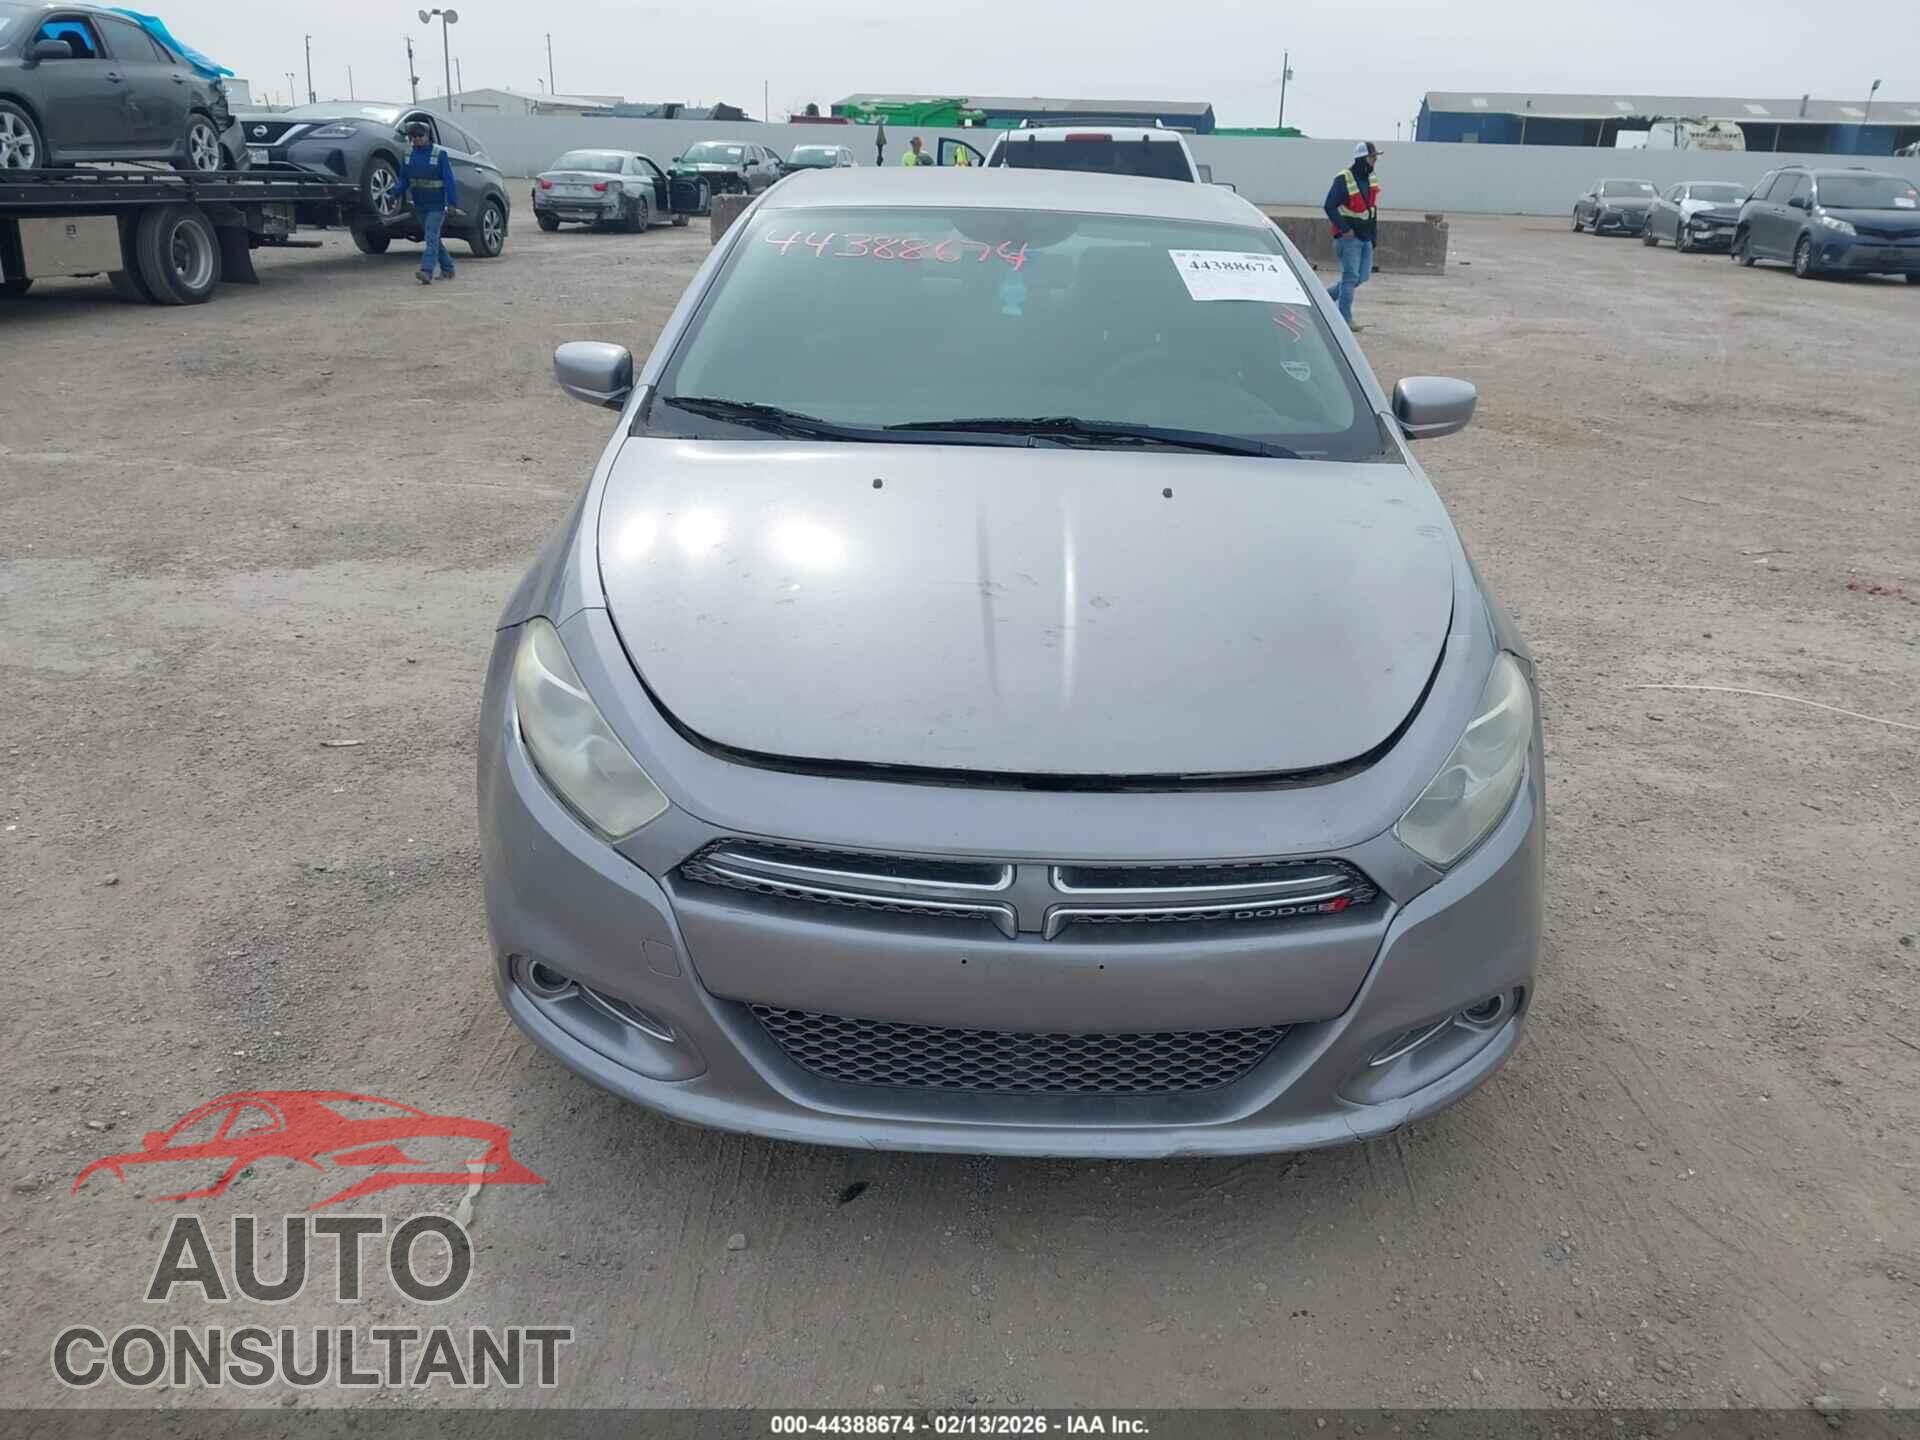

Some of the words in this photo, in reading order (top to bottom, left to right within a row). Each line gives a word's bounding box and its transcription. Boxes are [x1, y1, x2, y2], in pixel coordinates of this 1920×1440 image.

[766, 229, 1029, 271] 44388674
[1189, 260, 1279, 273] 44388674
[1234, 903, 1336, 919] DODGE
